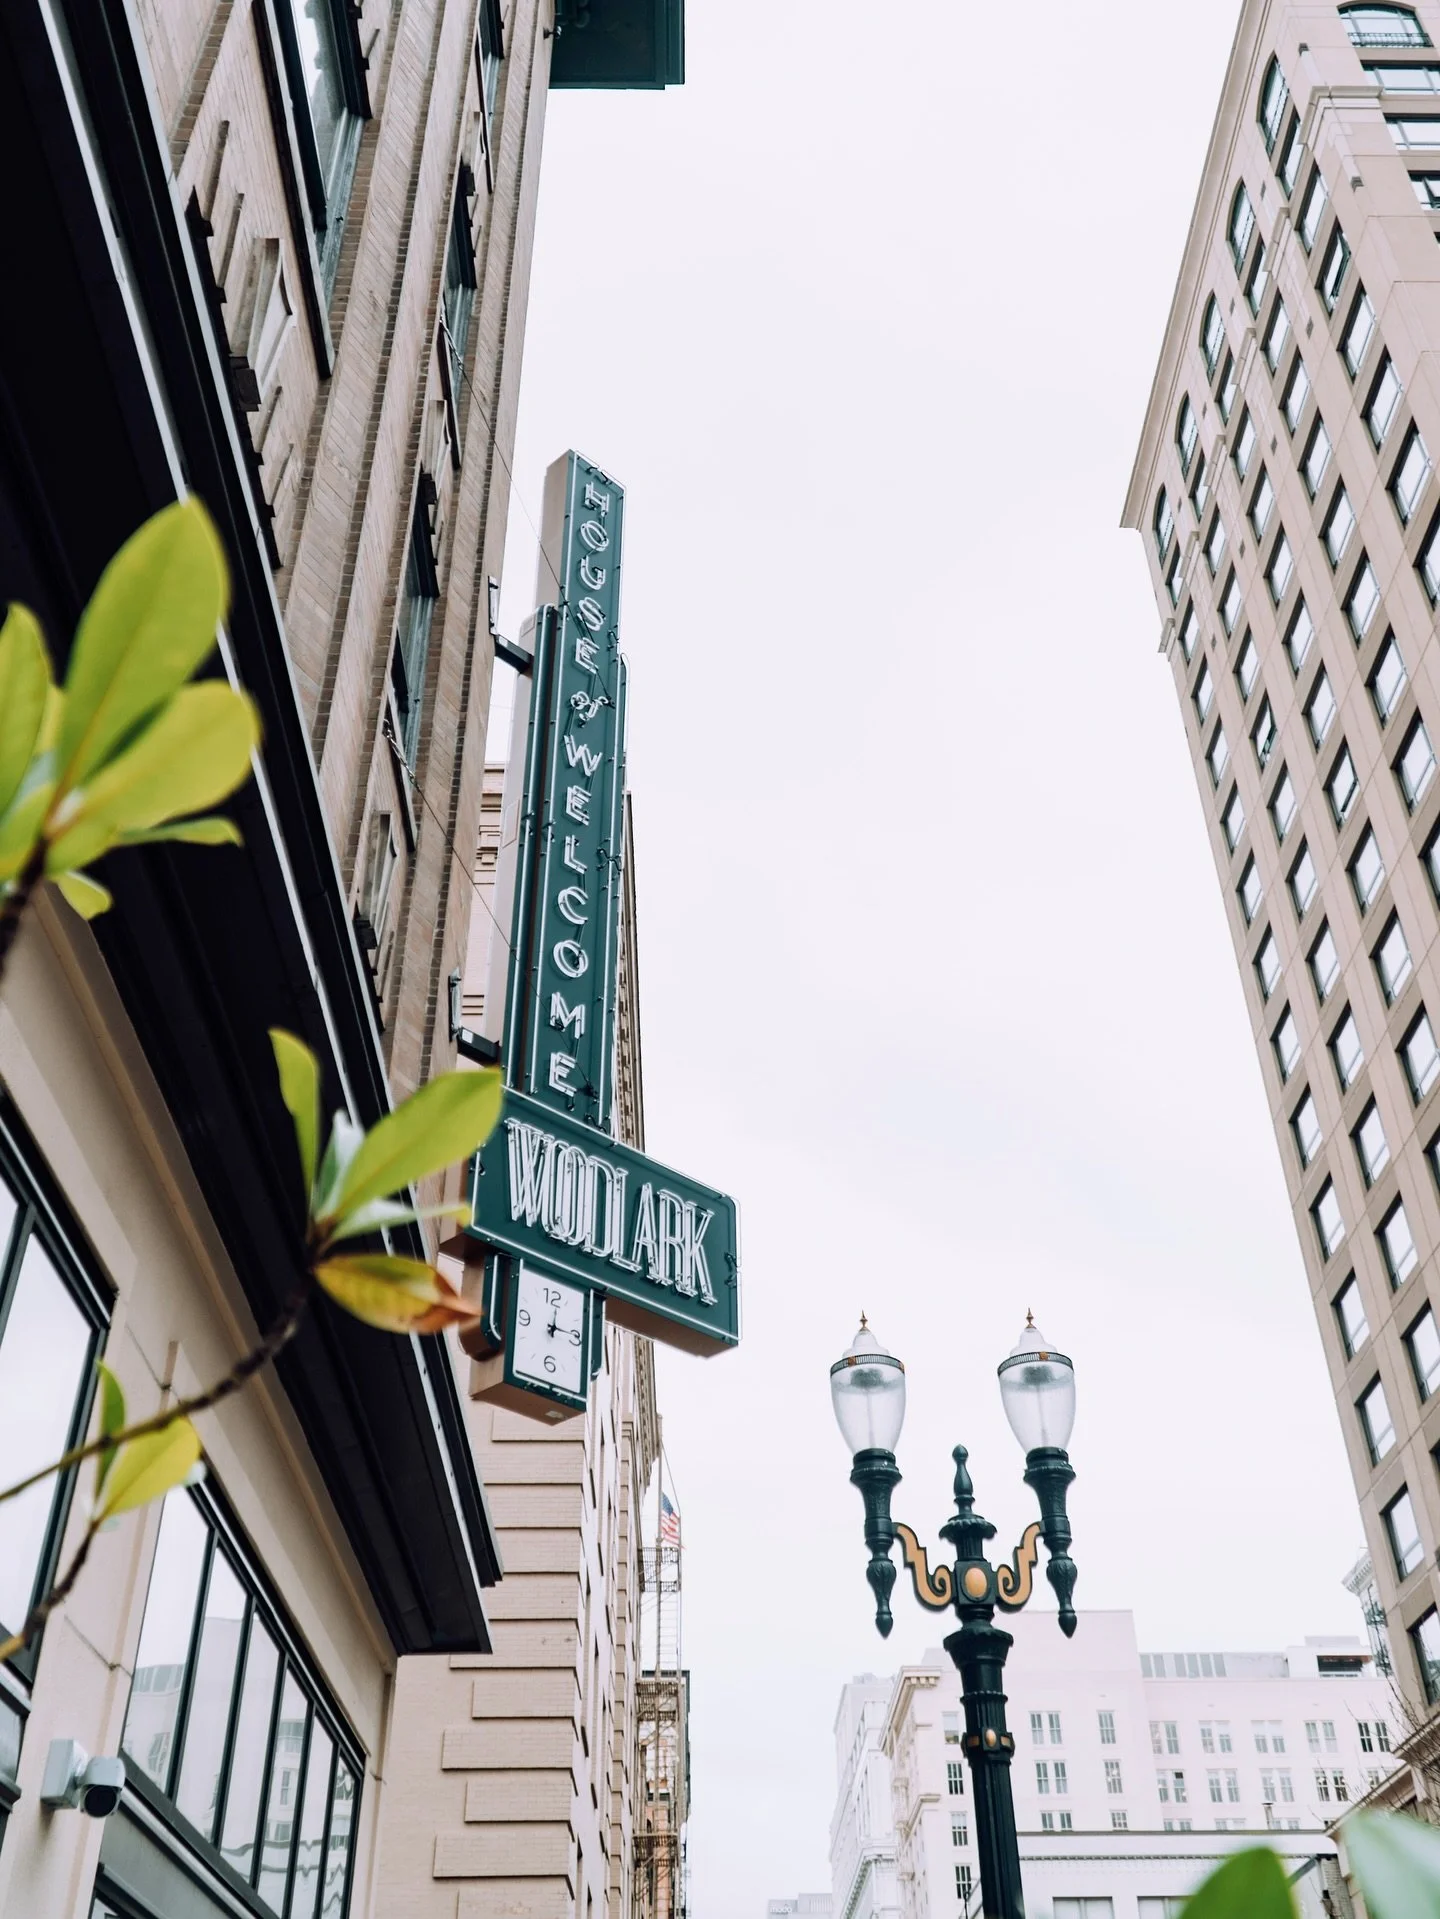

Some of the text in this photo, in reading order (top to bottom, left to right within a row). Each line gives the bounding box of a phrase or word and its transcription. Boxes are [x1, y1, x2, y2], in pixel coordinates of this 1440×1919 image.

[574, 480, 610, 675] HOUSE
[549, 734, 603, 1098] WELCOME
[503, 1117, 718, 1306] WOODLARK
[543, 1287, 562, 1309] 12
[519, 1309, 531, 1327] 9
[568, 1329, 582, 1347] 3
[543, 1355, 557, 1374] 6
